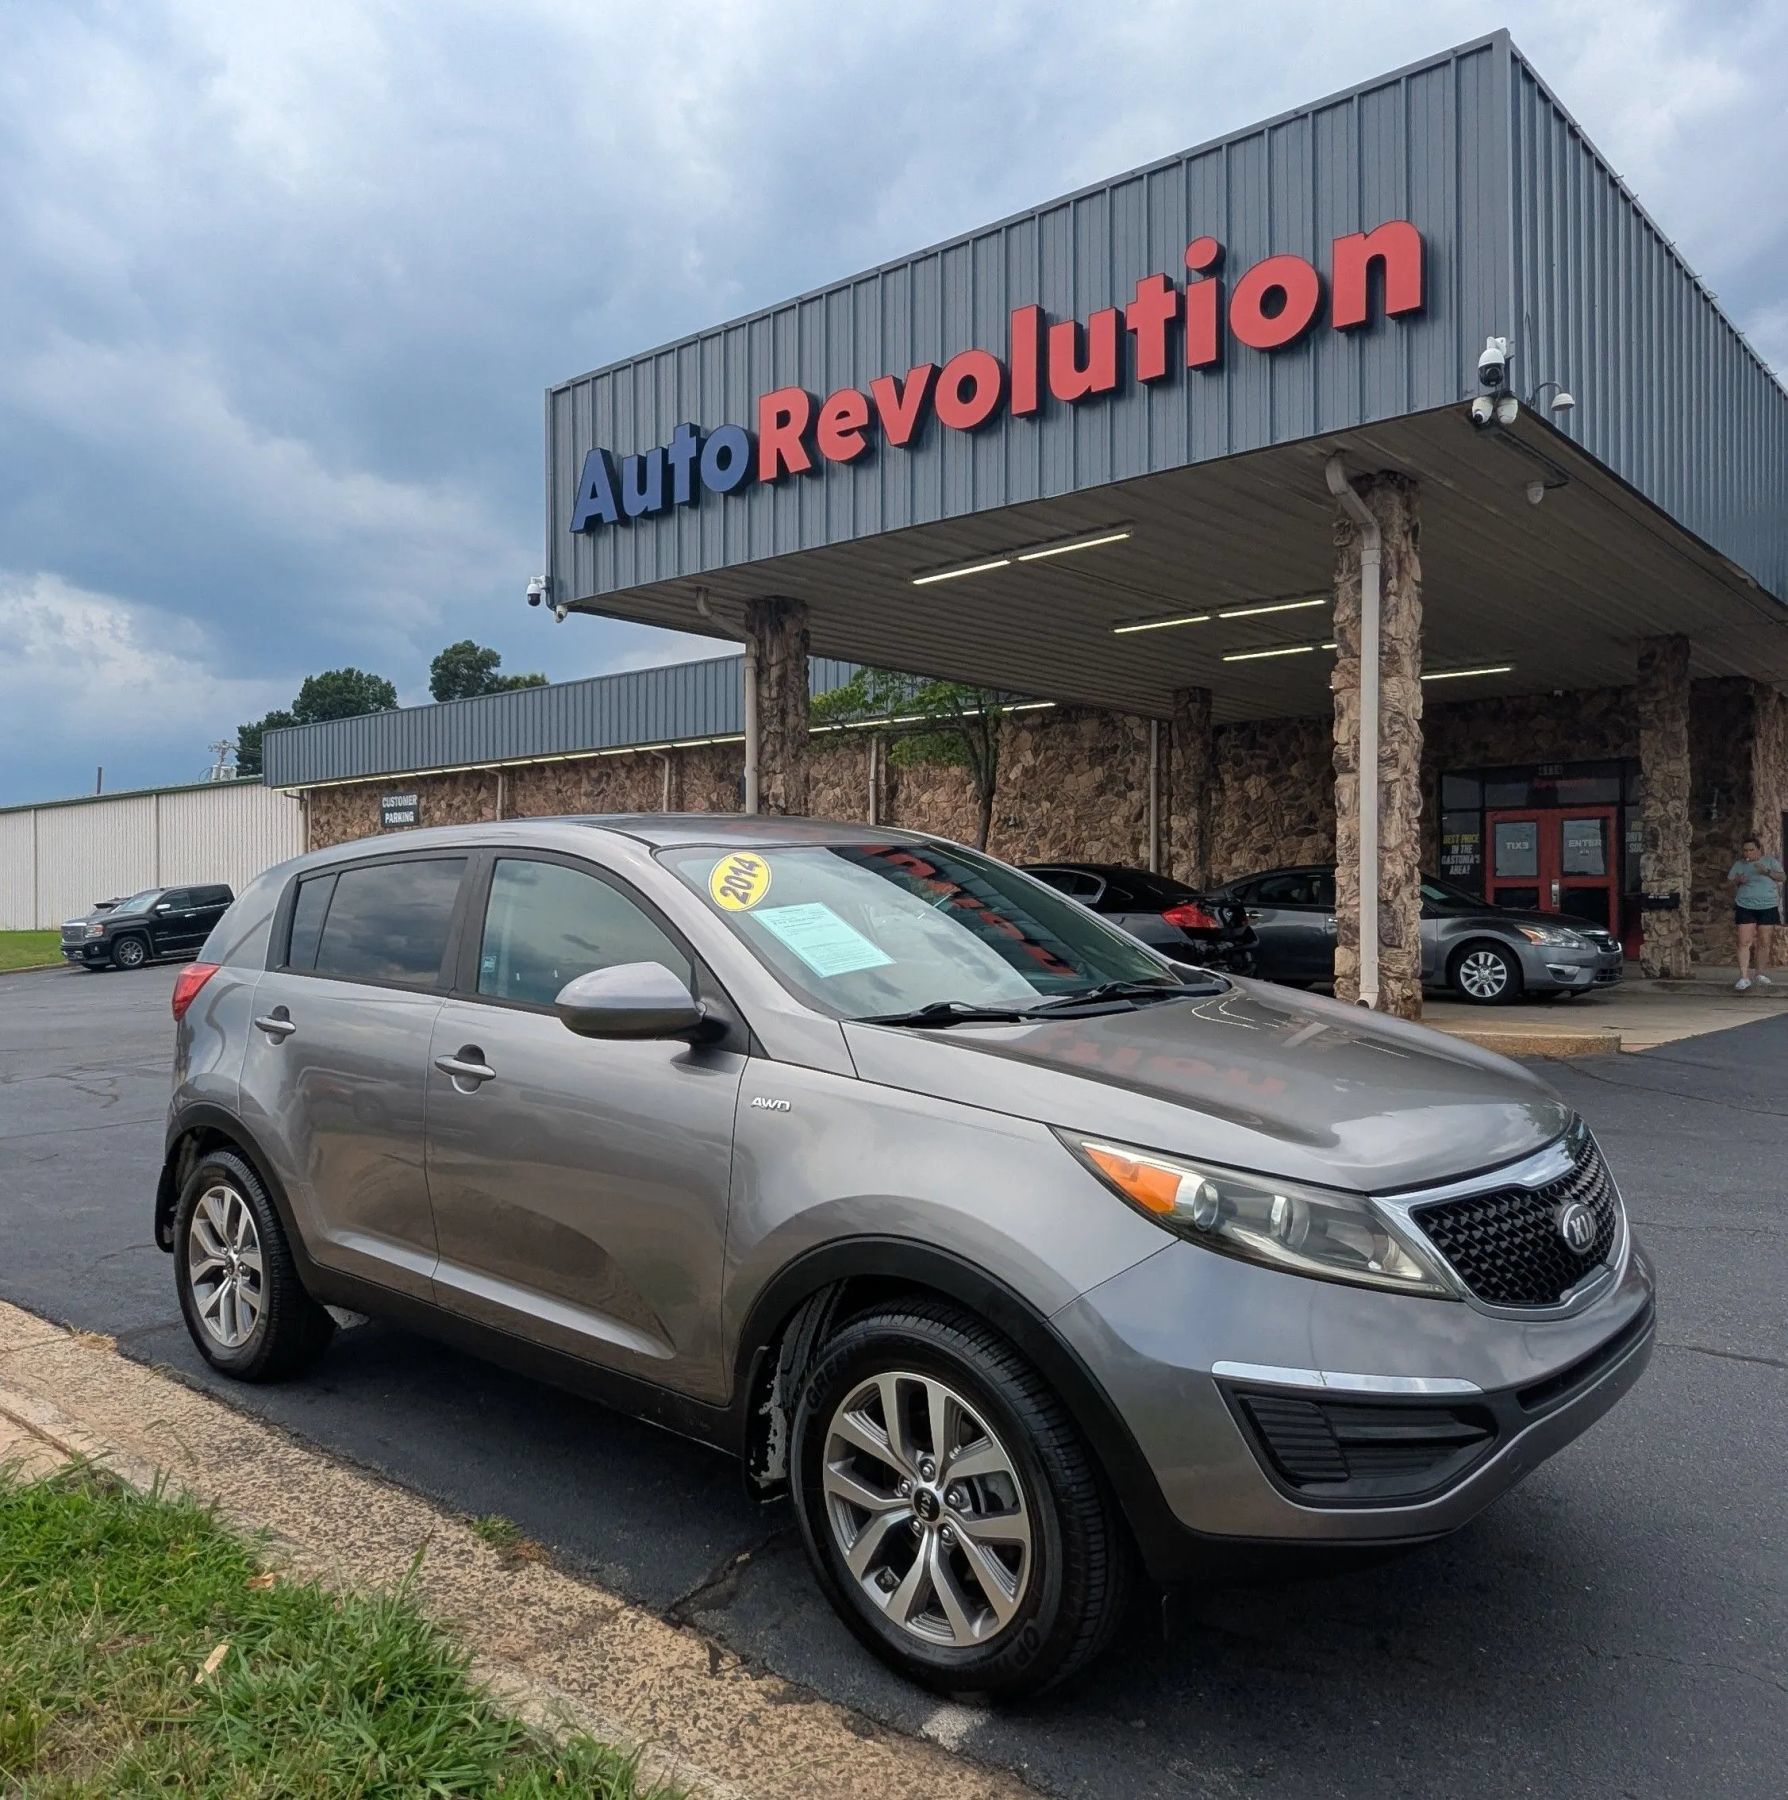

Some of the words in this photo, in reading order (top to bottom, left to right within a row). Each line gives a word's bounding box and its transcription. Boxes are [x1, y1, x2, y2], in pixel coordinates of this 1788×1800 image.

[382, 794, 417, 808] CUSTOMER
[385, 811, 414, 823] PARKING
[1460, 844, 1473, 854] THE
[1568, 839, 1601, 848] ENTER
[719, 857, 761, 905] 2014
[751, 1096, 791, 1112] AWD
[1570, 1212, 1597, 1245] KIA
[920, 1491, 932, 1518] KIA
